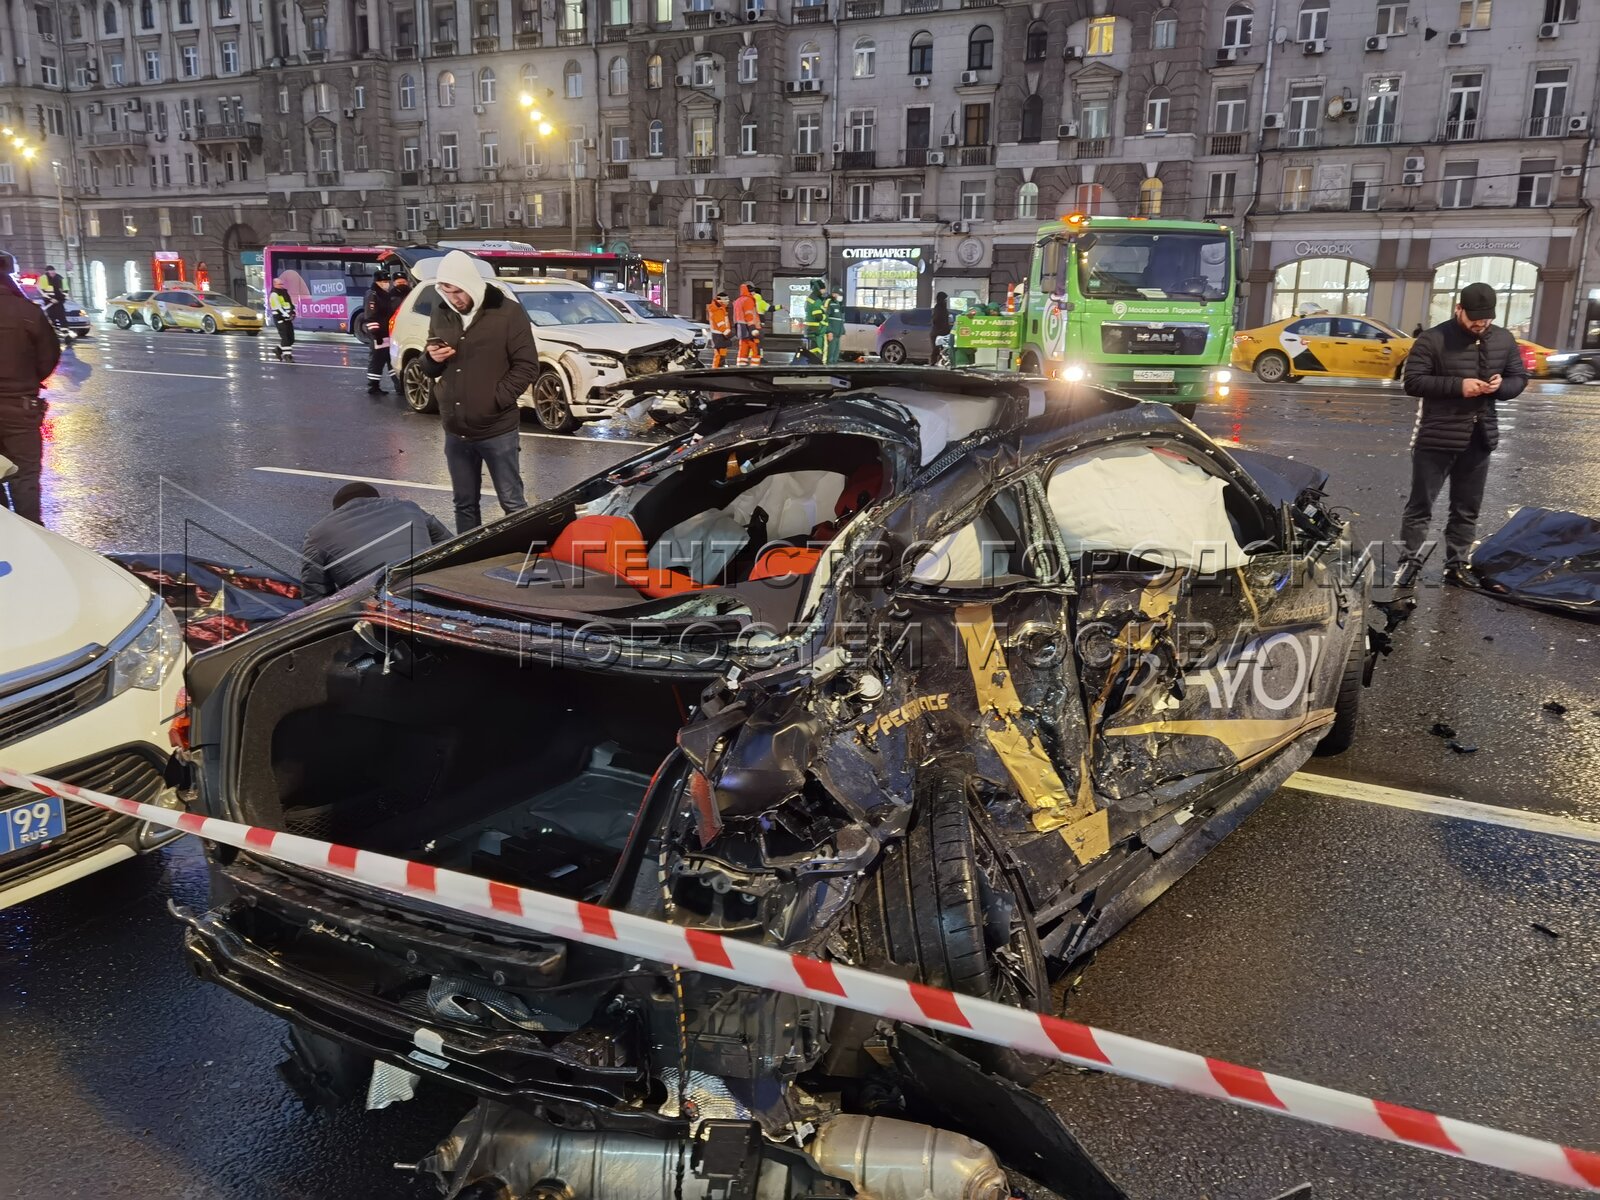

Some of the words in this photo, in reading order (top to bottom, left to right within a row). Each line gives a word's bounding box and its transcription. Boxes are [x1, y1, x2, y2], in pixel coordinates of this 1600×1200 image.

[1295, 241, 1353, 256] Очкарик
[1488, 241, 1521, 249] ОПТИКИ
[842, 248, 911, 258] СУПЕРМАРКЕТ
[1136, 333, 1175, 342] MAN
[13, 803, 50, 834] 99
[20, 828, 48, 844] RUS
